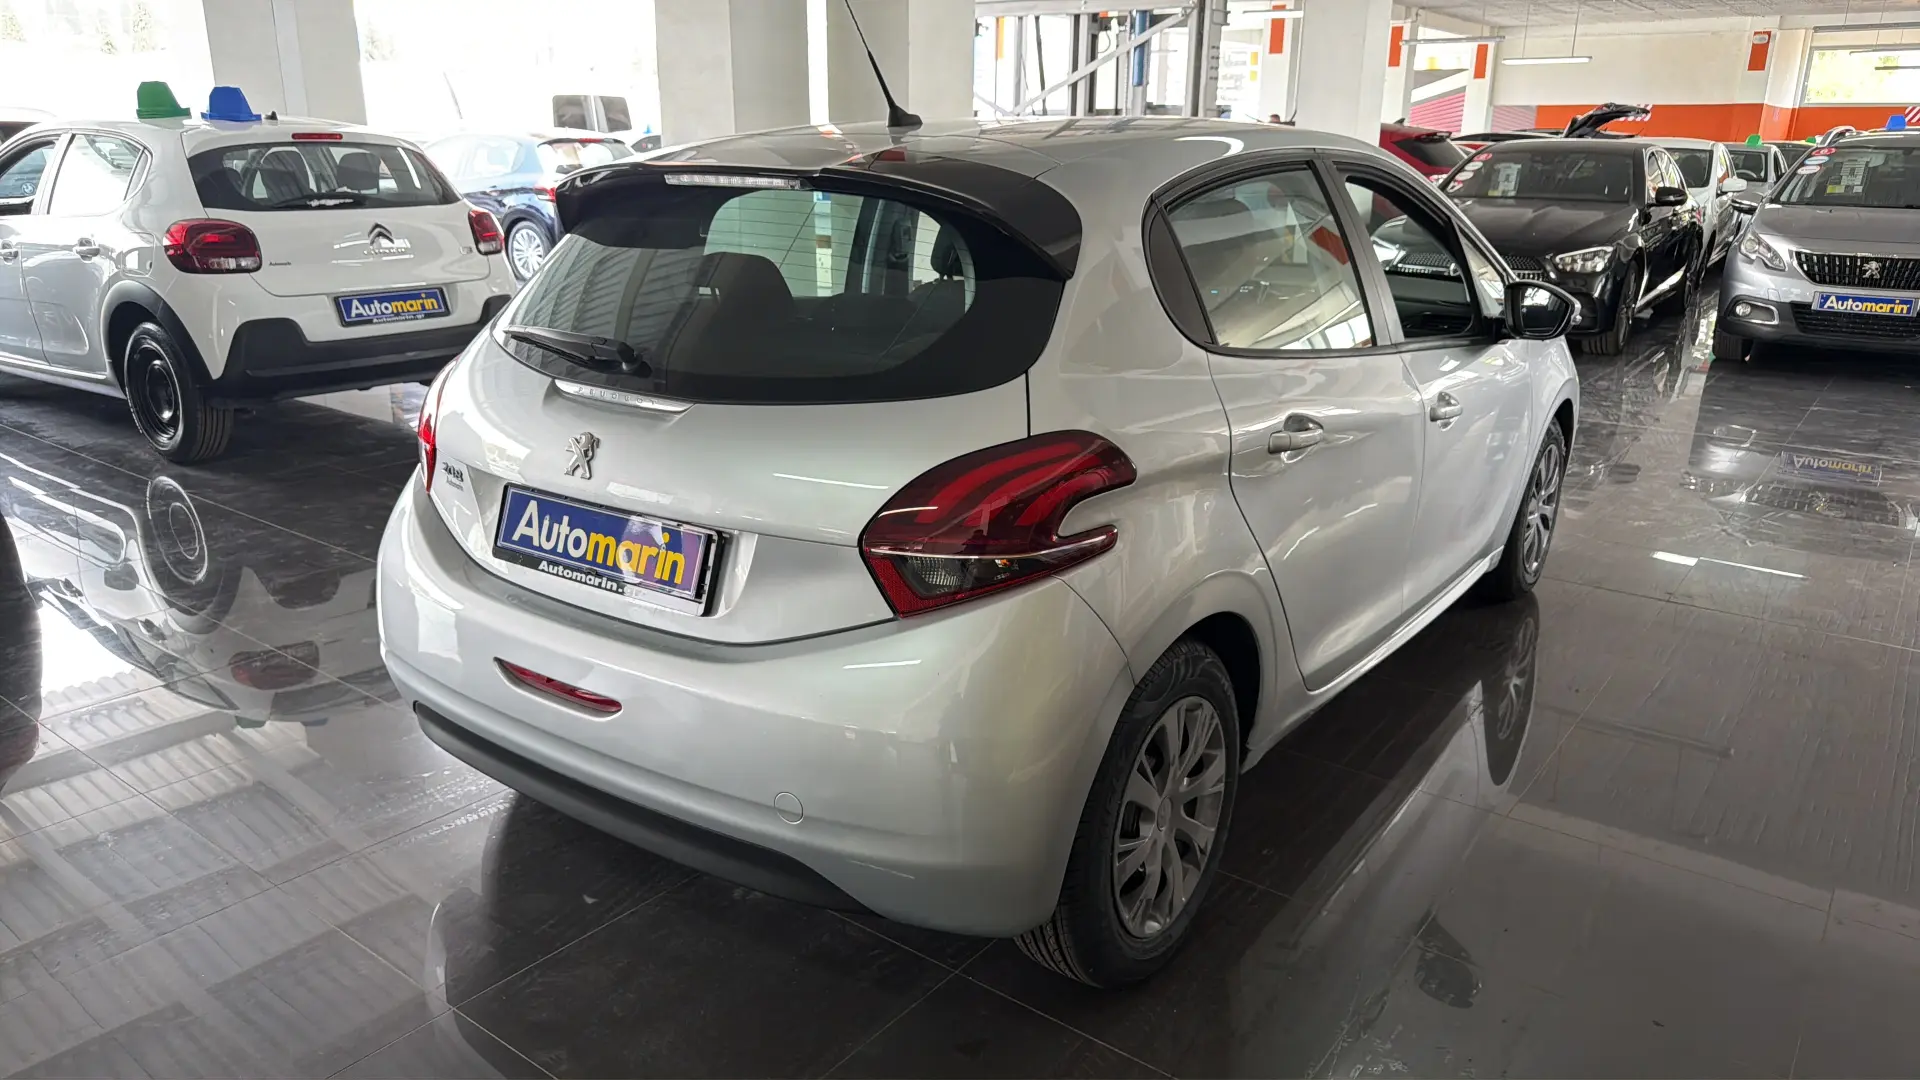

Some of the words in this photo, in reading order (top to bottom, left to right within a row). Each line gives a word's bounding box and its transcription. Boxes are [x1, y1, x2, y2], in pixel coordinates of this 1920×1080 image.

[350, 293, 438, 318] Automarin
[1823, 295, 1909, 314] Automarin
[511, 500, 686, 586] Automarin
